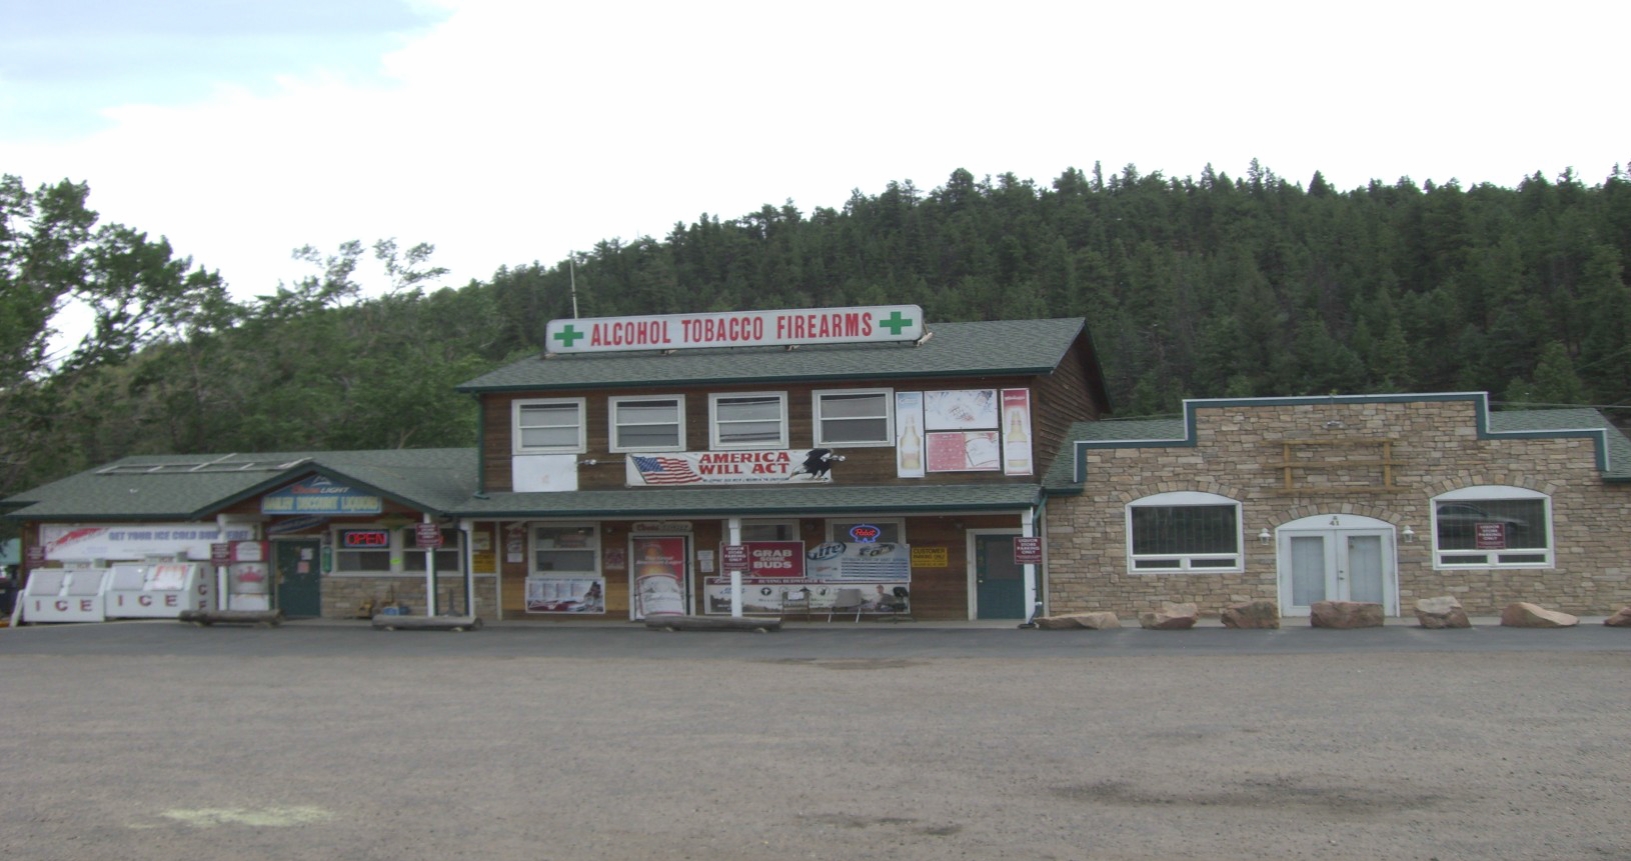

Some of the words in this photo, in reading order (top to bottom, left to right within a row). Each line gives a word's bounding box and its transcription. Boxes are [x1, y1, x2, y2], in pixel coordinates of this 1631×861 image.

[590, 320, 671, 346] ALCOHOL
[681, 316, 764, 343] TOBACCO
[776, 312, 873, 340] FIREARMS
[700, 451, 790, 464] AMERICA
[700, 464, 742, 475] WILL
[751, 463, 789, 474] ACT
[109, 531, 125, 541] GET
[128, 531, 152, 541] YOUR
[155, 531, 170, 541] ICE
[172, 531, 197, 541] COLD
[855, 528, 876, 536] Pabst
[346, 532, 386, 545] OPEN
[753, 549, 793, 557] GRAB
[753, 561, 792, 569] BUDS
[35, 600, 93, 612] ICE
[118, 595, 178, 607] ICE
